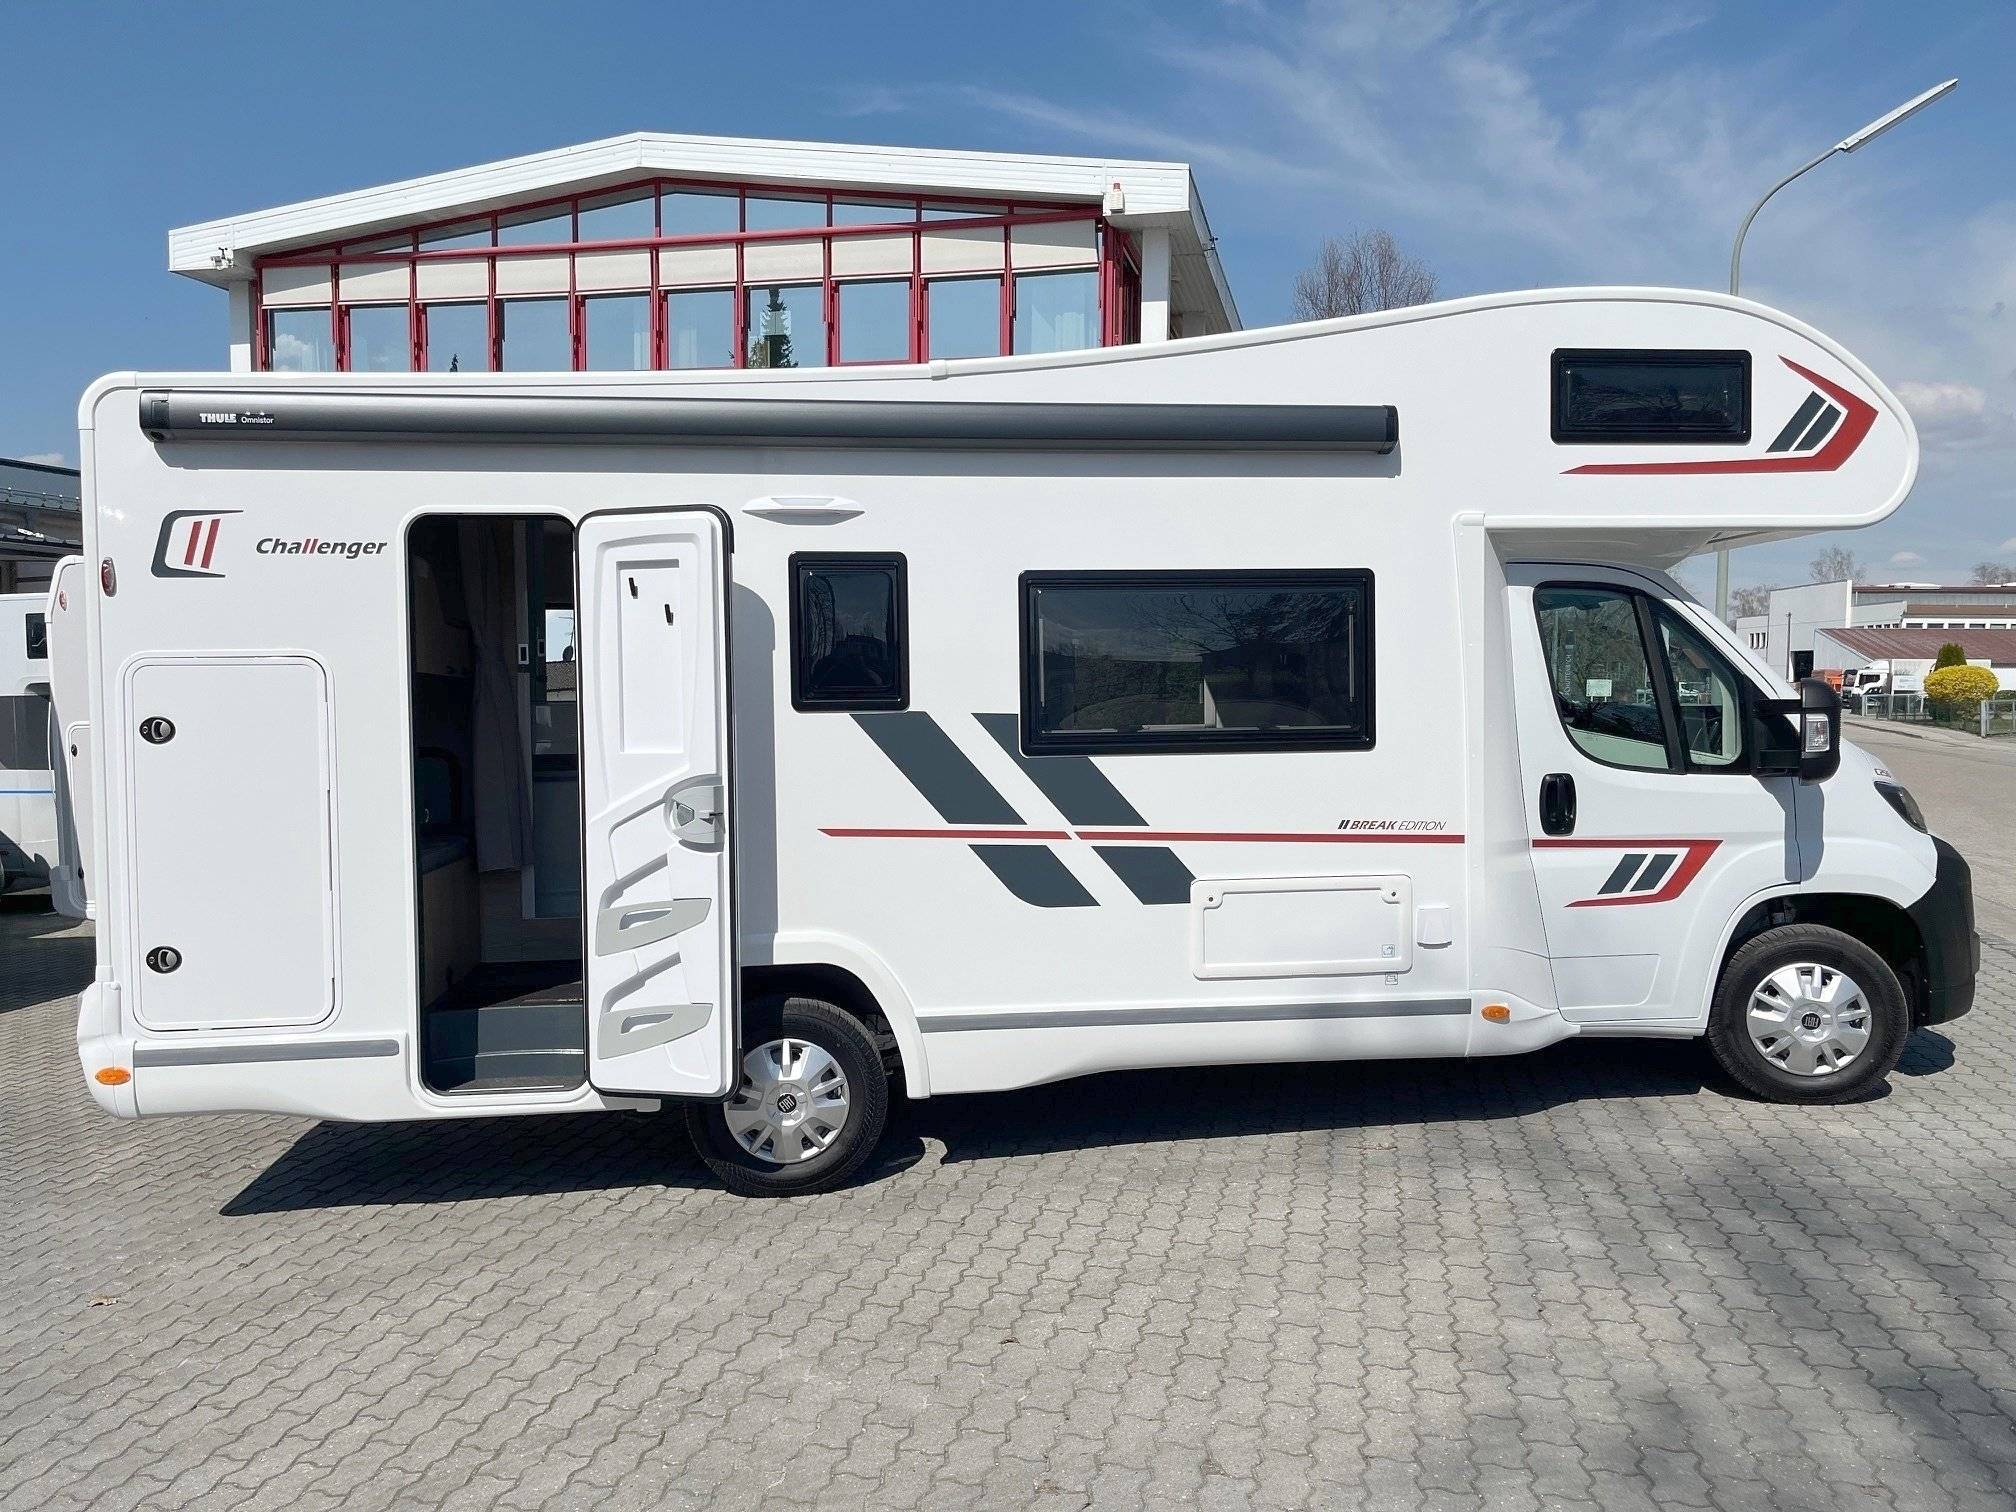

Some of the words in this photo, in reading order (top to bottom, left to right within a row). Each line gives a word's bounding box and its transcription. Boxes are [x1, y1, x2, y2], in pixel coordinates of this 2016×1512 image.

[200, 413, 237, 423] THULE
[241, 416, 274, 424] Omnistor
[256, 538, 387, 560] Challenger
[1350, 820, 1398, 830] BREAK
[1398, 820, 1447, 831] EDITION
[778, 1095, 795, 1112] FIAT
